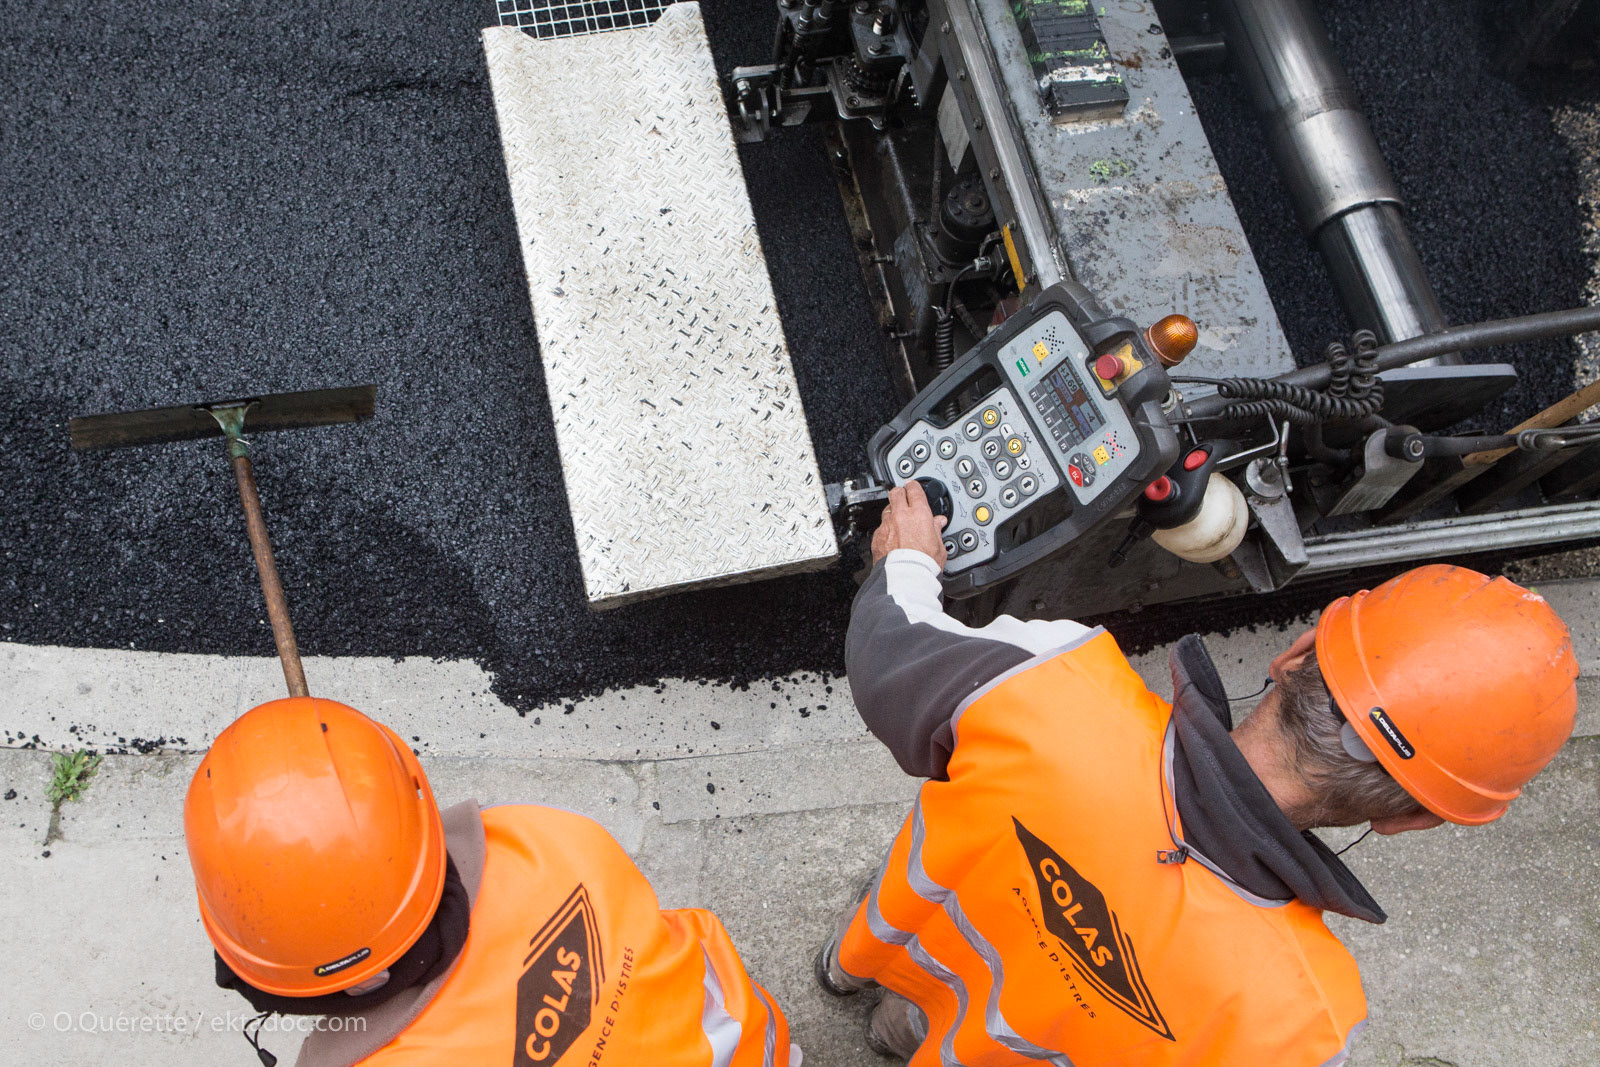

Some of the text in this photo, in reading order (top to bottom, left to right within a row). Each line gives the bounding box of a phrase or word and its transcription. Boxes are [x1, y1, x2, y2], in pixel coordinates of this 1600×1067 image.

[1060, 366, 1079, 393] +1.69
[986, 443, 996, 454] R
[1071, 470, 1080, 481] ESC
[1039, 857, 1114, 967] COLAS
[610, 946, 634, 1012] D'ISTRES
[1012, 887, 1096, 1019] AGENCE D'ISTRES
[525, 946, 581, 1062] COLAS
